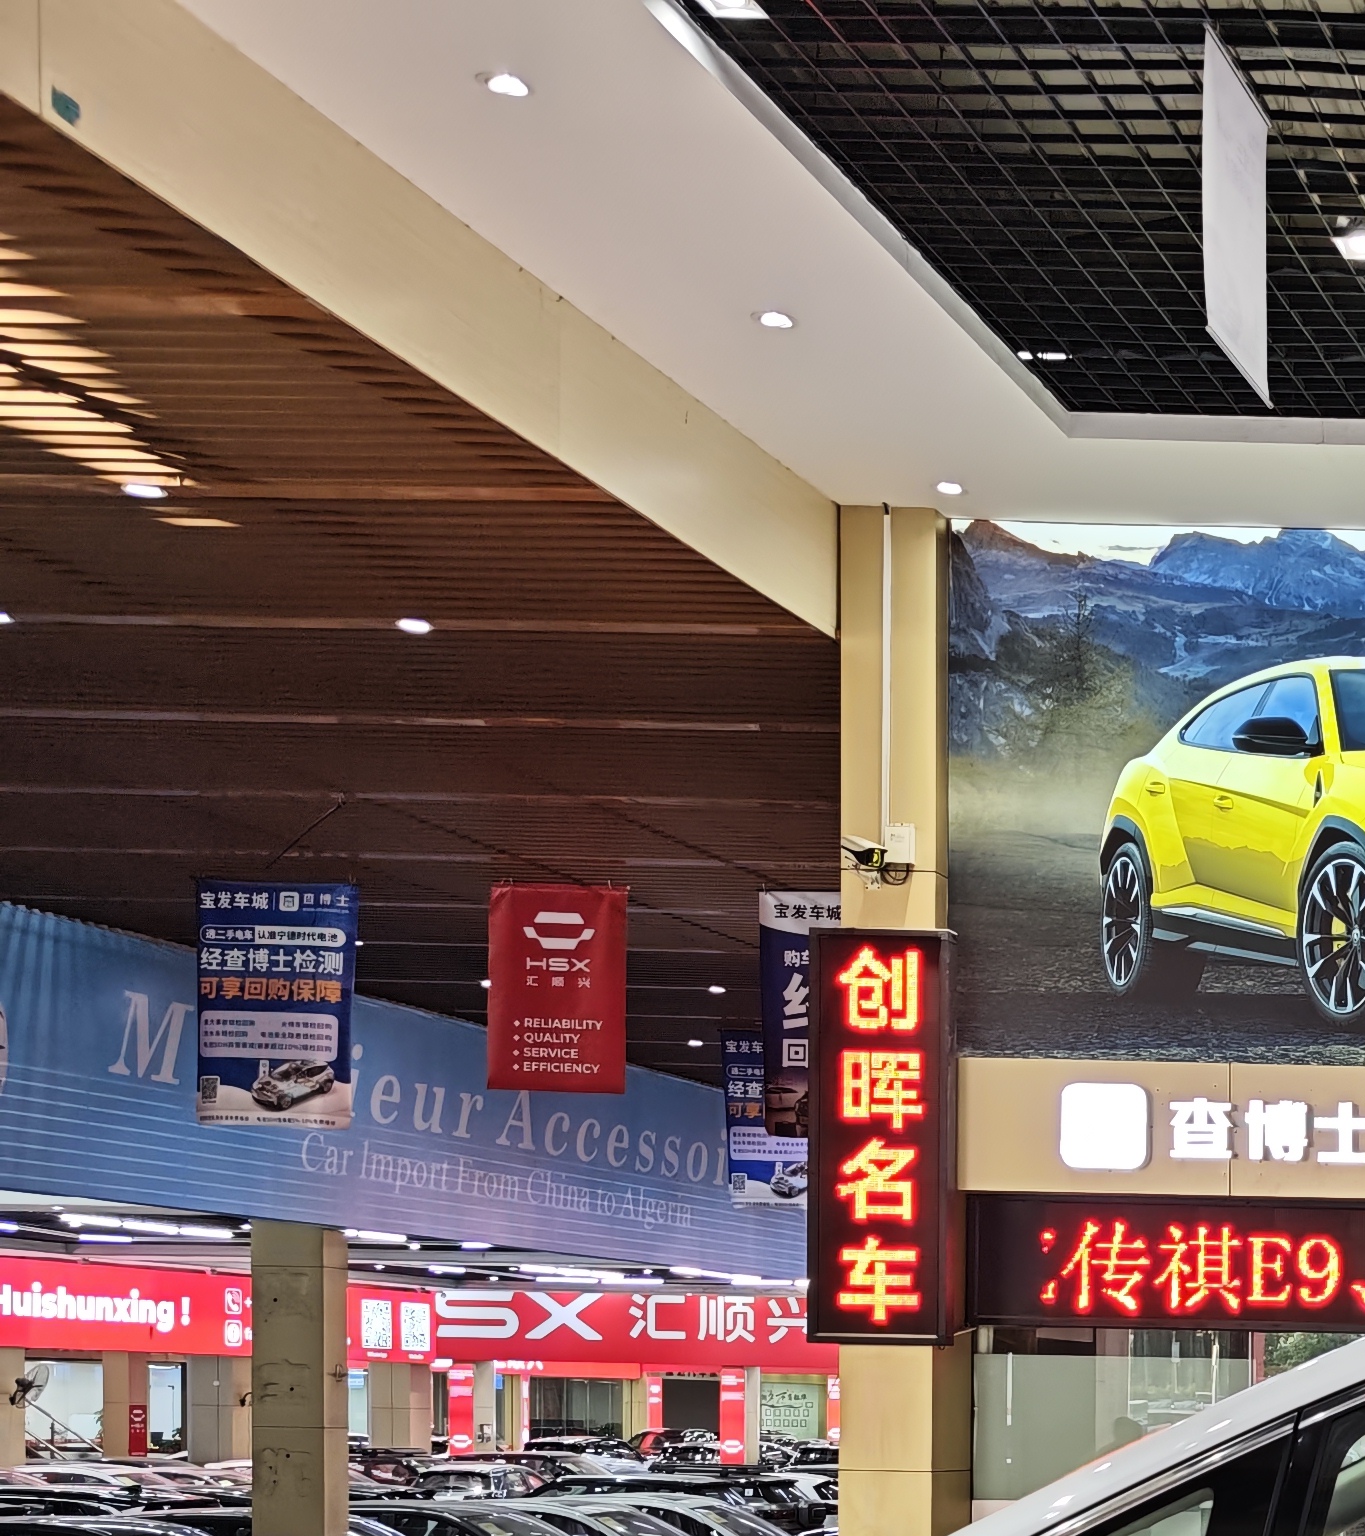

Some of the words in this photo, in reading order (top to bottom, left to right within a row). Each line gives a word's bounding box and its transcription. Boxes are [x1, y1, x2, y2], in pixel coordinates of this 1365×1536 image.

[200, 891, 269, 910] 宝发车城
[774, 903, 841, 921] 宝发车城
[200, 947, 344, 975] 经查博士检测
[526, 957, 591, 972] HSX
[200, 976, 342, 1003] 可享回购保障
[526, 975, 591, 988] 汇顺兴
[524, 1017, 603, 1030] RELIABILITY
[523, 1032, 580, 1043] QUALITY
[523, 1047, 579, 1059] SERVICE
[523, 1061, 600, 1073] EFFICIENCY
[728, 1081, 762, 1098] 经查
[728, 1102, 765, 1119] 可享
[837, 946, 923, 1325] 创晖名车
[301, 1132, 353, 1176] Car
[360, 1139, 451, 1195] Import
[457, 1157, 519, 1199] From
[527, 1170, 591, 1209] China
[594, 1184, 616, 1210] to
[620, 1191, 693, 1232] Algeria
[0, 1281, 175, 1333] Huishunxing
[629, 1293, 808, 1344] 汇顺兴
